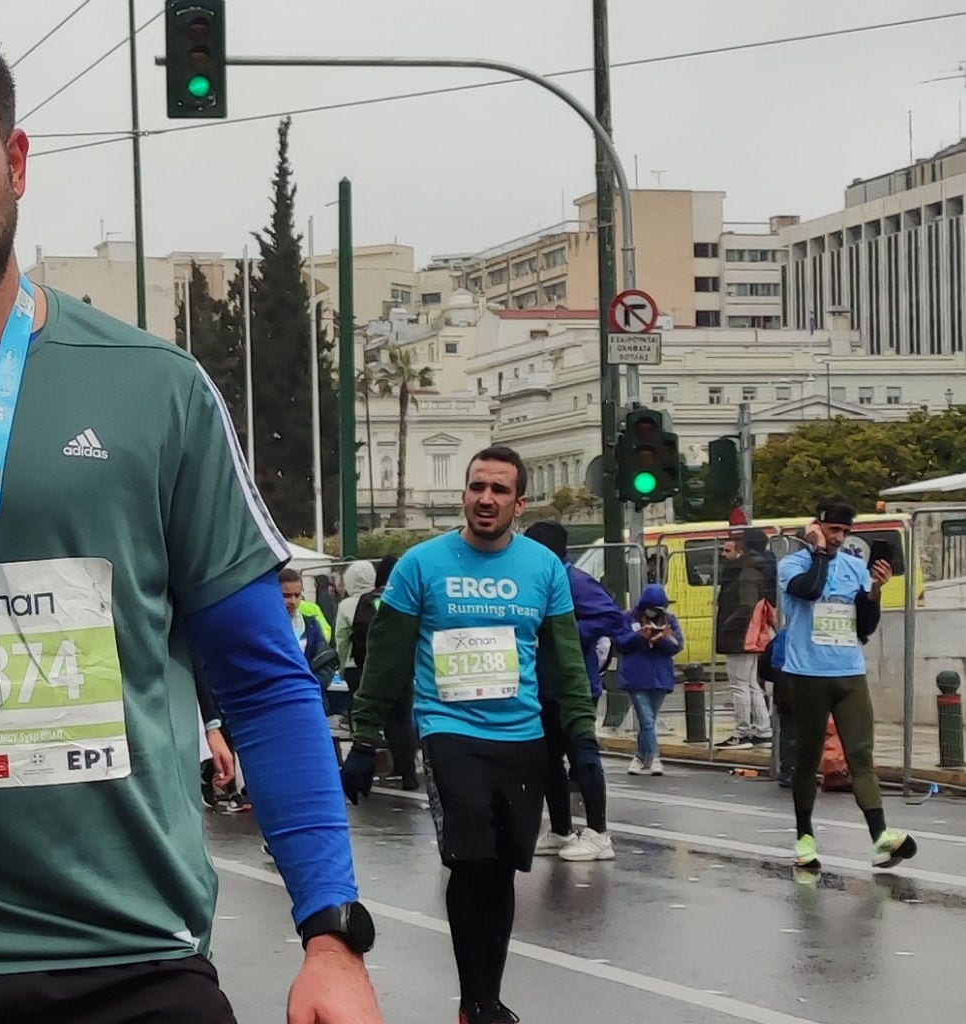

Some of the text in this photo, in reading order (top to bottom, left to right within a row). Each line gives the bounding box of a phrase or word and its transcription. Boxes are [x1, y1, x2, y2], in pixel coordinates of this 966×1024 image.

[63, 445, 109, 459] adidas
[445, 576, 518, 600] ERGO
[447, 602, 539, 617] Running Team
[447, 652, 507, 676] 51288
